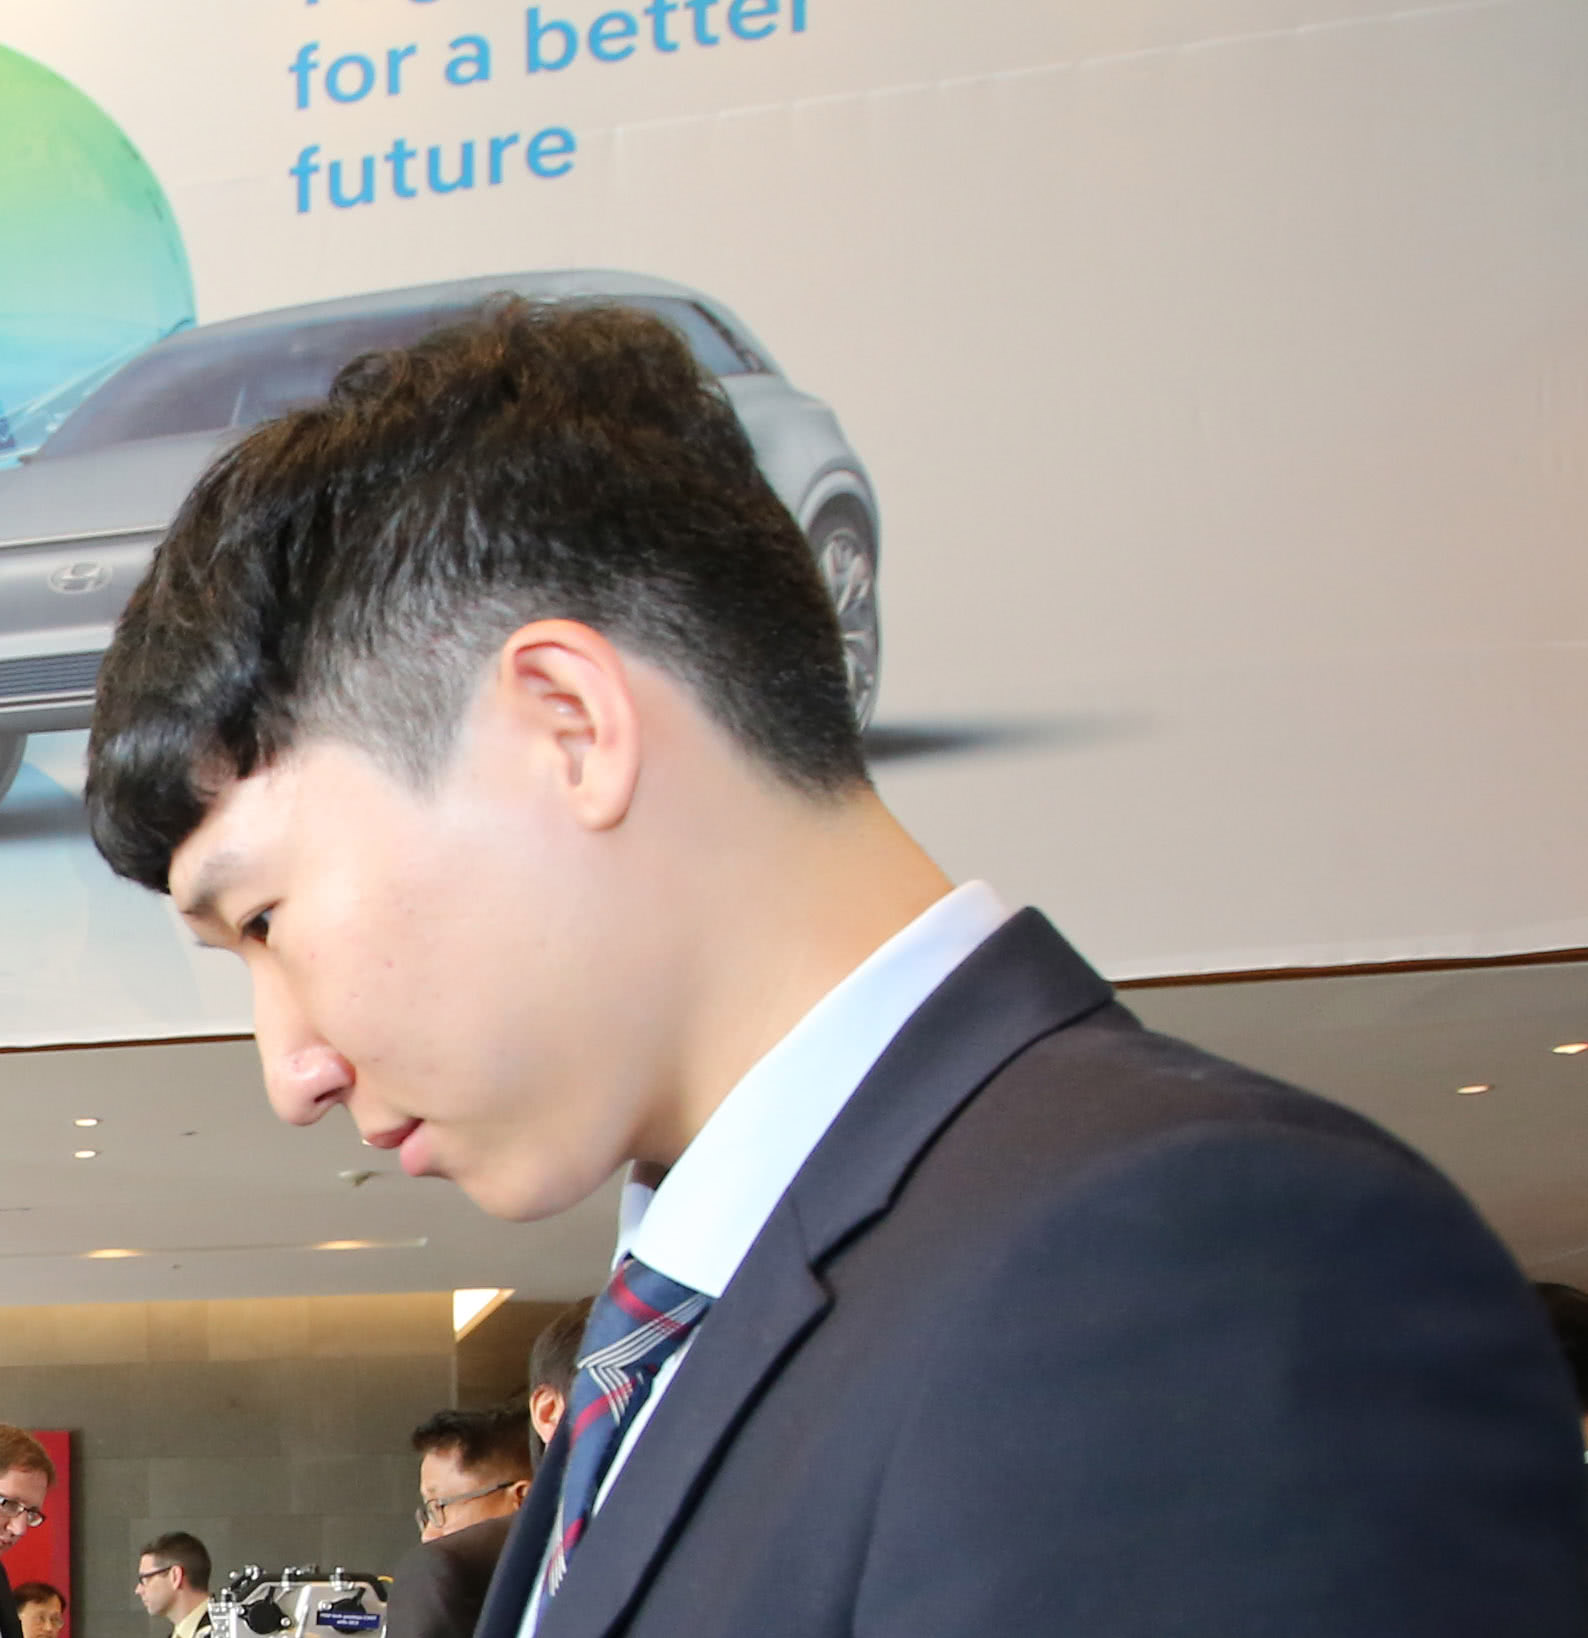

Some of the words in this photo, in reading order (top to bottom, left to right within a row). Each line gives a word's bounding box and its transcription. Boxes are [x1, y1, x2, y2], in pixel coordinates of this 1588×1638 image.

[289, 41, 418, 109] for
[445, 34, 492, 86] a
[289, 126, 577, 214] future
